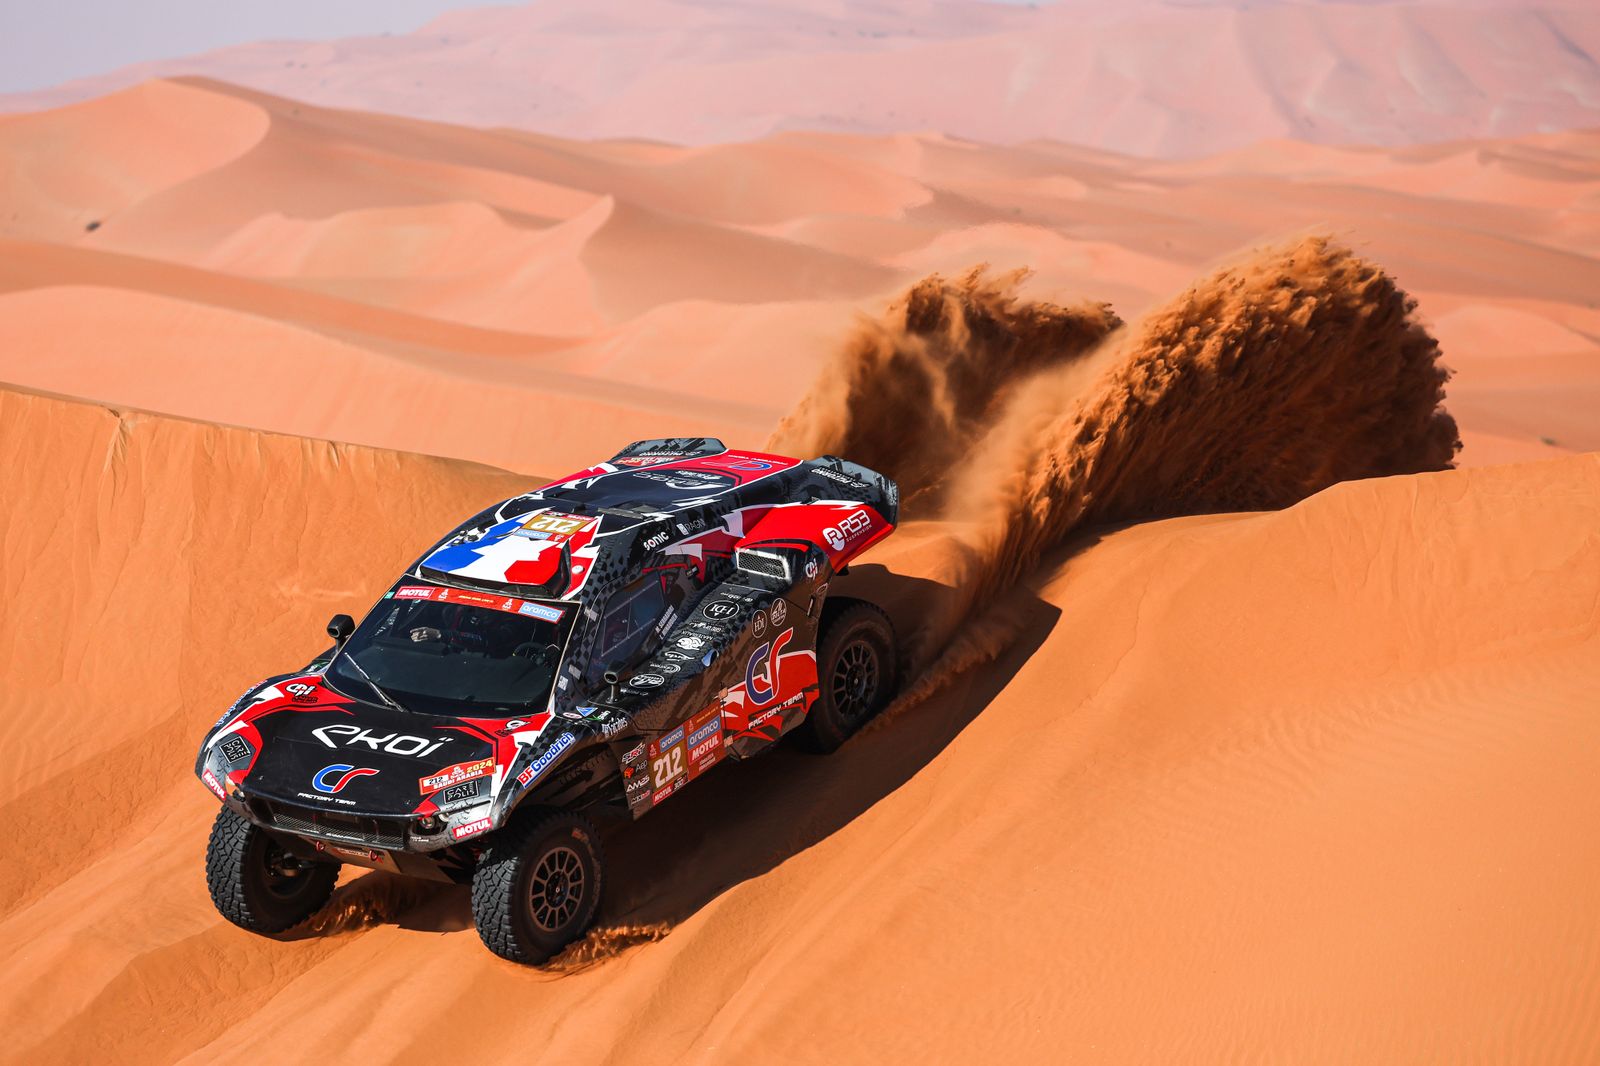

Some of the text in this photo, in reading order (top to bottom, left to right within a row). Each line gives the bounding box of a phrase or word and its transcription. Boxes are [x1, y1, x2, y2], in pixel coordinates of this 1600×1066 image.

[531, 515, 581, 532] 212
[399, 587, 430, 597] MOTUL
[522, 605, 558, 619] aramco
[748, 692, 804, 729] FACTORY TEAM
[660, 730, 683, 749] aramco
[689, 720, 719, 745] aramco
[517, 731, 575, 785] BFGoodrich
[691, 736, 719, 761] MOTUL
[466, 759, 493, 773] 2024
[653, 746, 683, 789] 212
[204, 770, 226, 799] MOTUL
[428, 776, 444, 785] 212
[433, 769, 483, 790] SAUDI ARABIA
[297, 792, 357, 806] FACTORY TEAM
[654, 786, 672, 802] MOTUL
[456, 819, 491, 838] MOTUL
